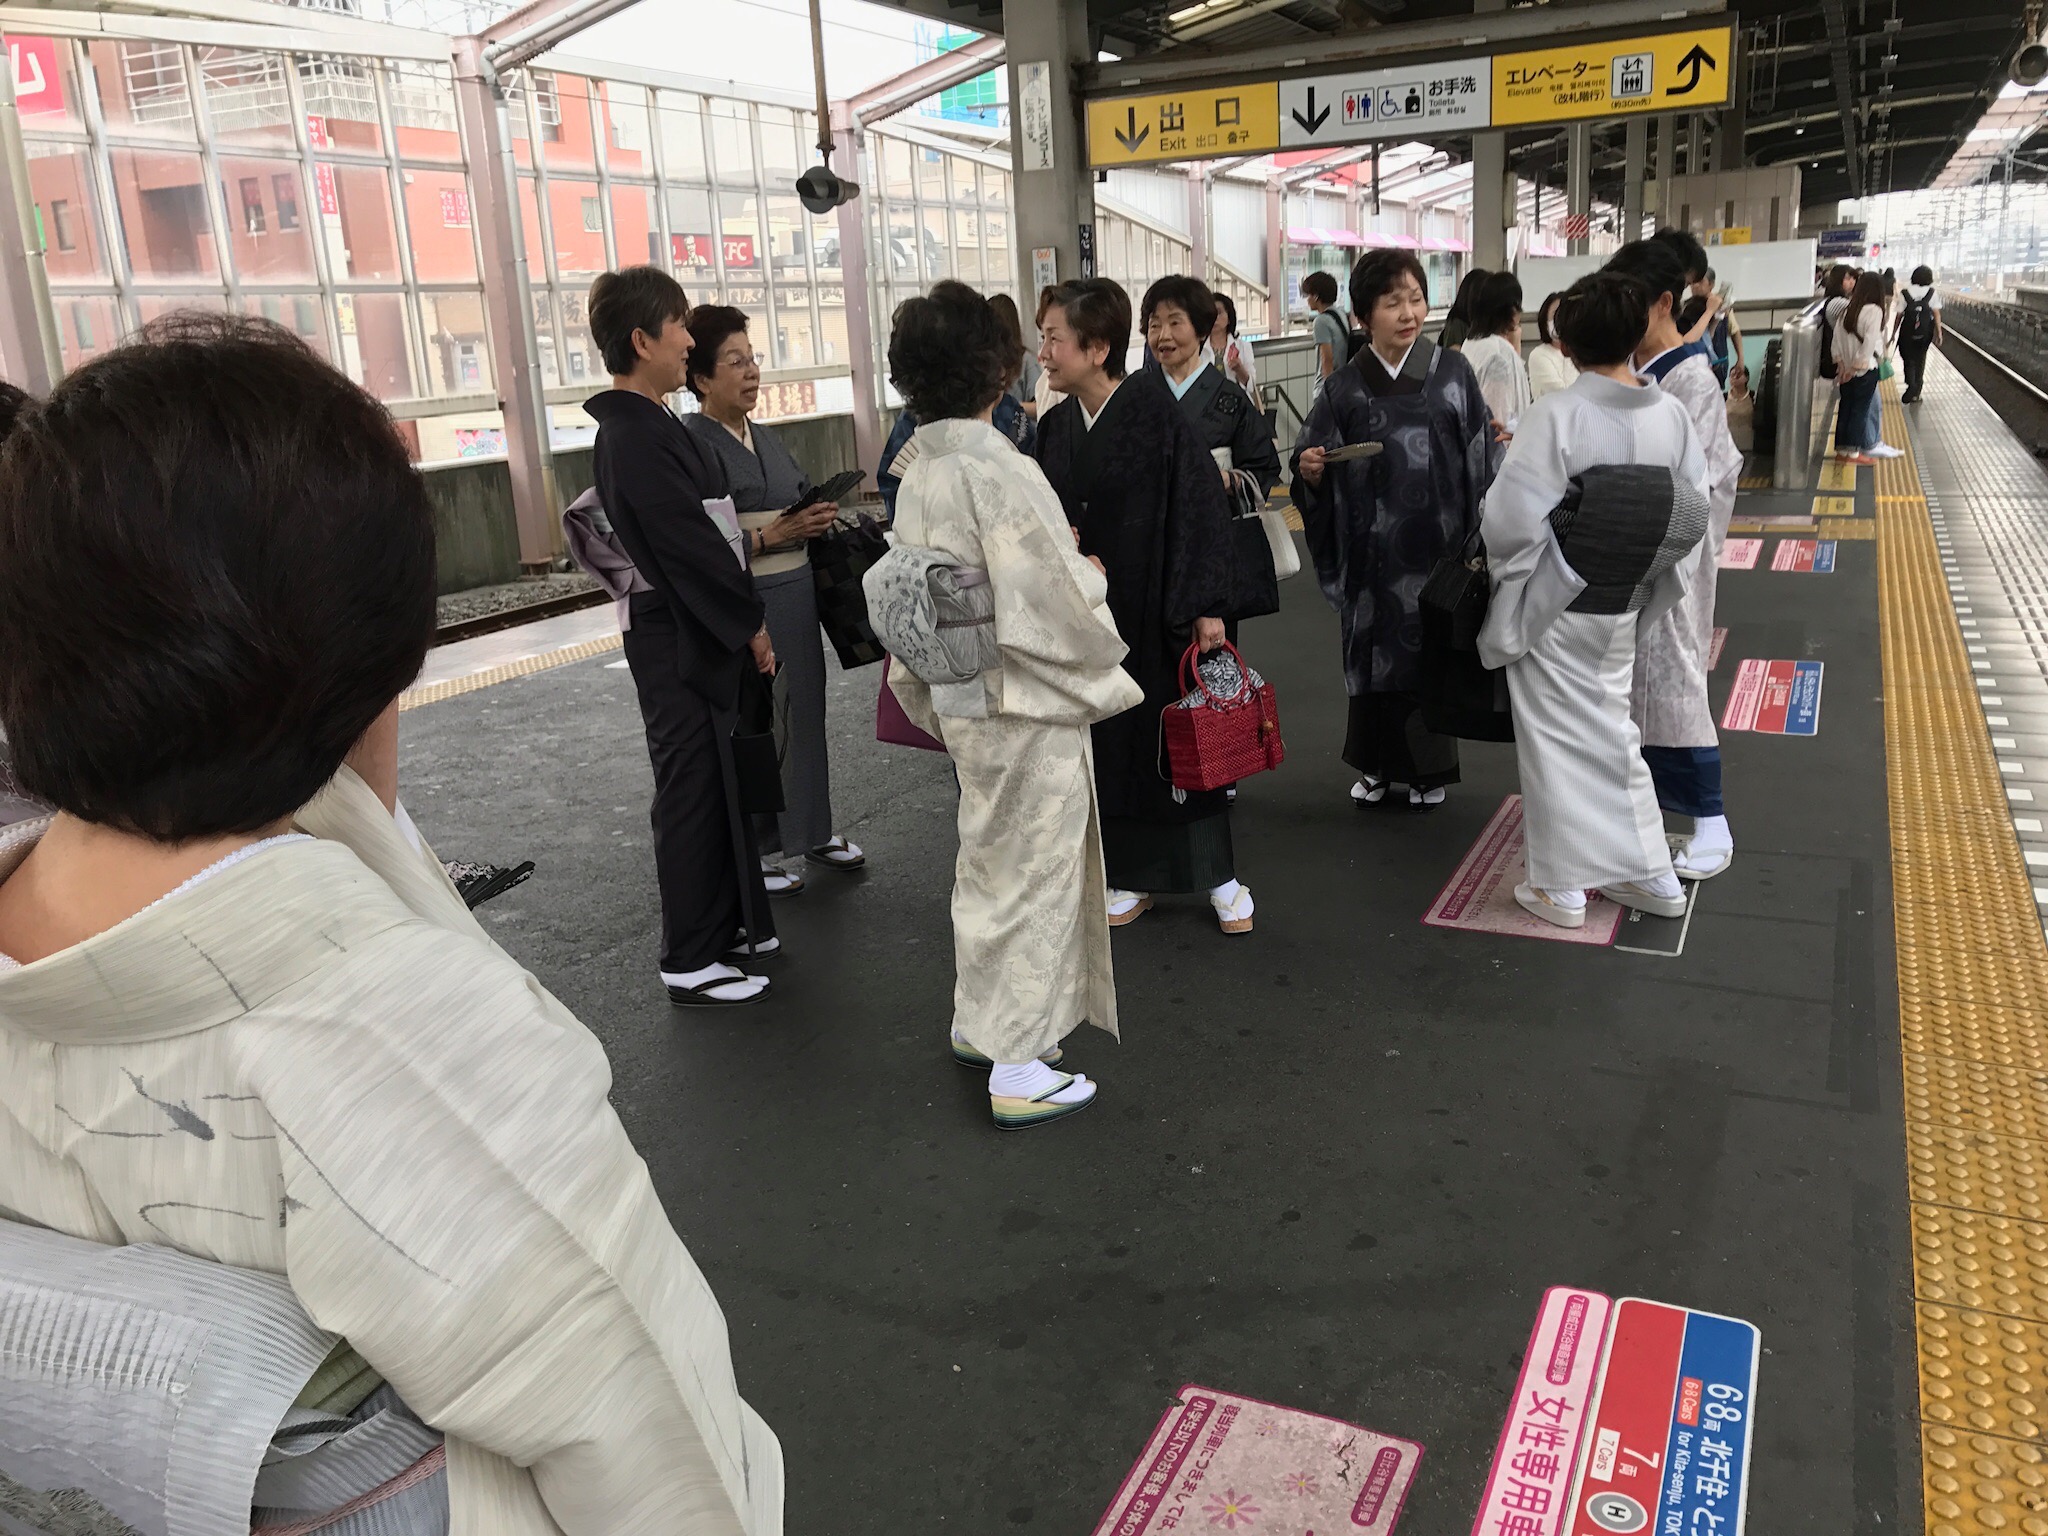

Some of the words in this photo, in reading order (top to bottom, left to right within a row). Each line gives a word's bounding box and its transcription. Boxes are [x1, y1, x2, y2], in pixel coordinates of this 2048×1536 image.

[1505, 61, 1606, 86] エレベーター
[1428, 75, 1476, 96] お手洗
[1507, 86, 1543, 97] Elevator
[1160, 97, 1240, 133] 出口
[1160, 136, 1187, 151] Exit
[1196, 133, 1218, 148] 出口
[1680, 1398, 1698, 1421] Cars
[1602, 1438, 1615, 1446] 7
[1677, 1431, 1693, 1447] for
[1596, 1447, 1613, 1471] Cars
[1666, 1449, 1693, 1505] Kita-senju,
[1607, 1505, 1626, 1519] H
